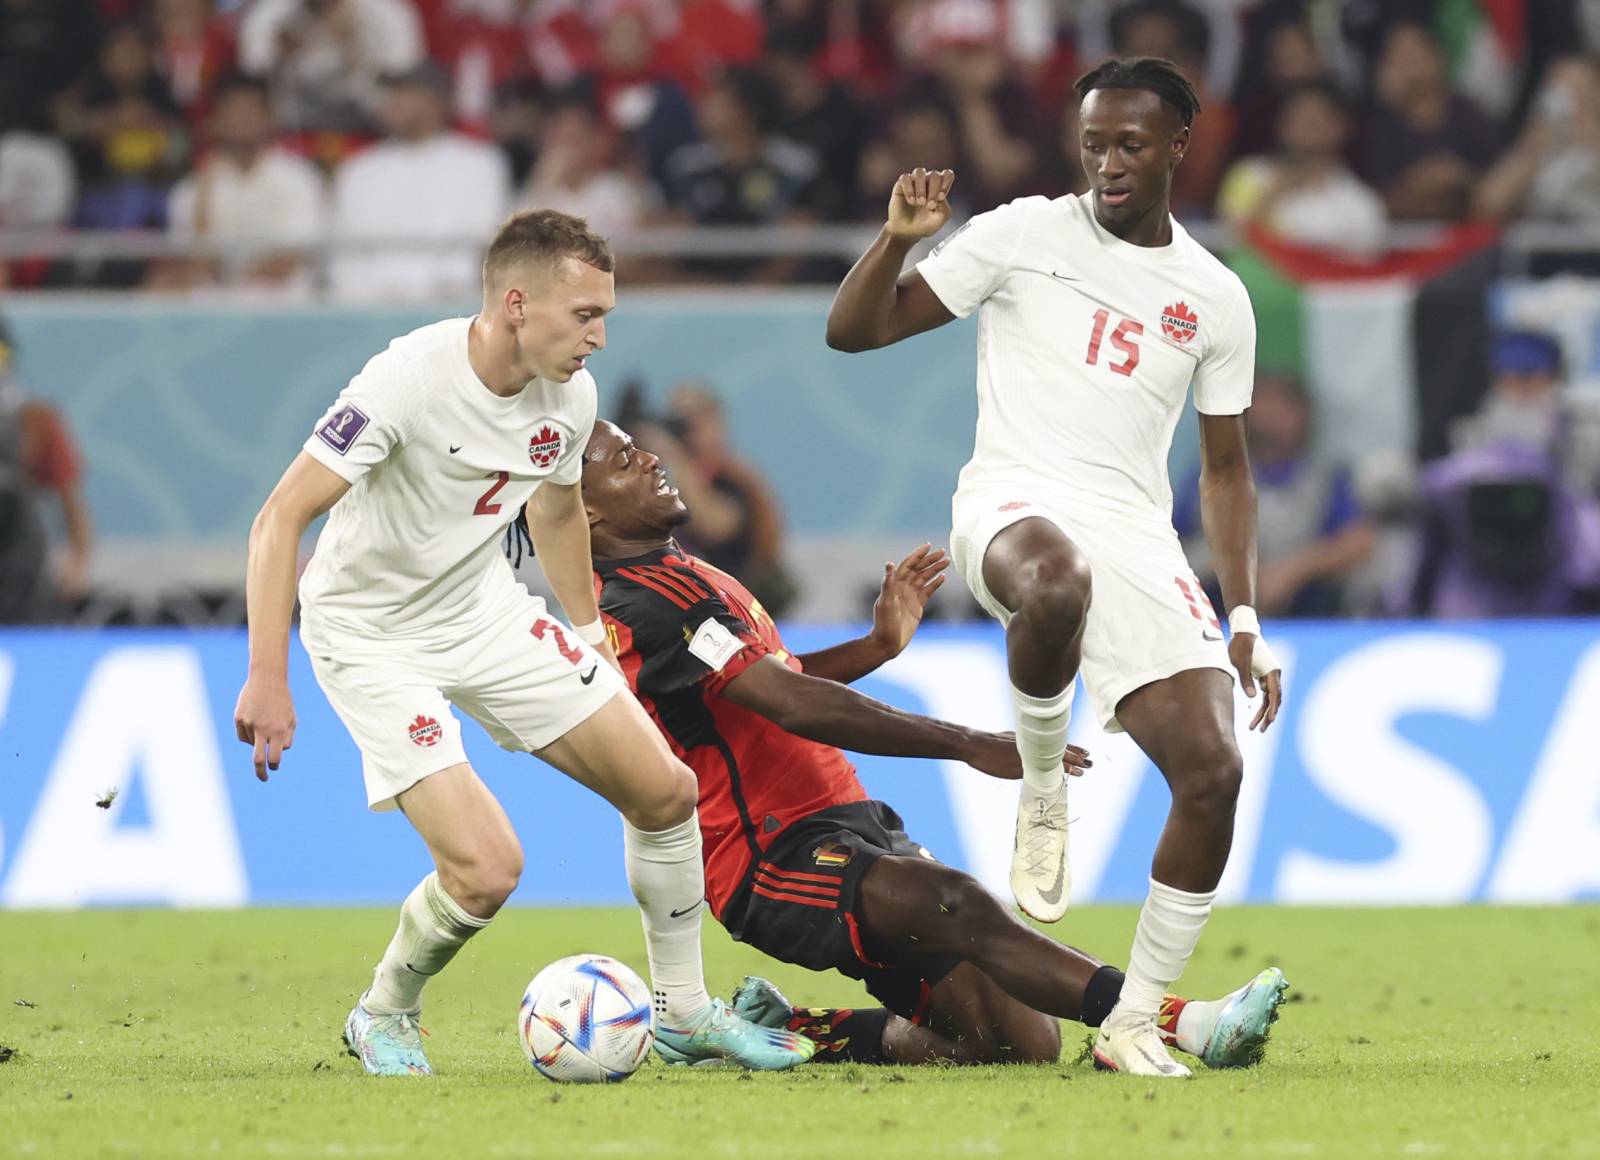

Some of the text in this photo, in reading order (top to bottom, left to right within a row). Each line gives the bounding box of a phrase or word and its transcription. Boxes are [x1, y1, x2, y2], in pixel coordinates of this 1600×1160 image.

[1085, 308, 1144, 377] 15
[1161, 315, 1199, 332] CANADA
[528, 441, 561, 454] CANADA
[472, 471, 510, 516] 2
[529, 618, 584, 666] 2
[410, 723, 441, 739] CANADA
[0, 645, 251, 909] A
